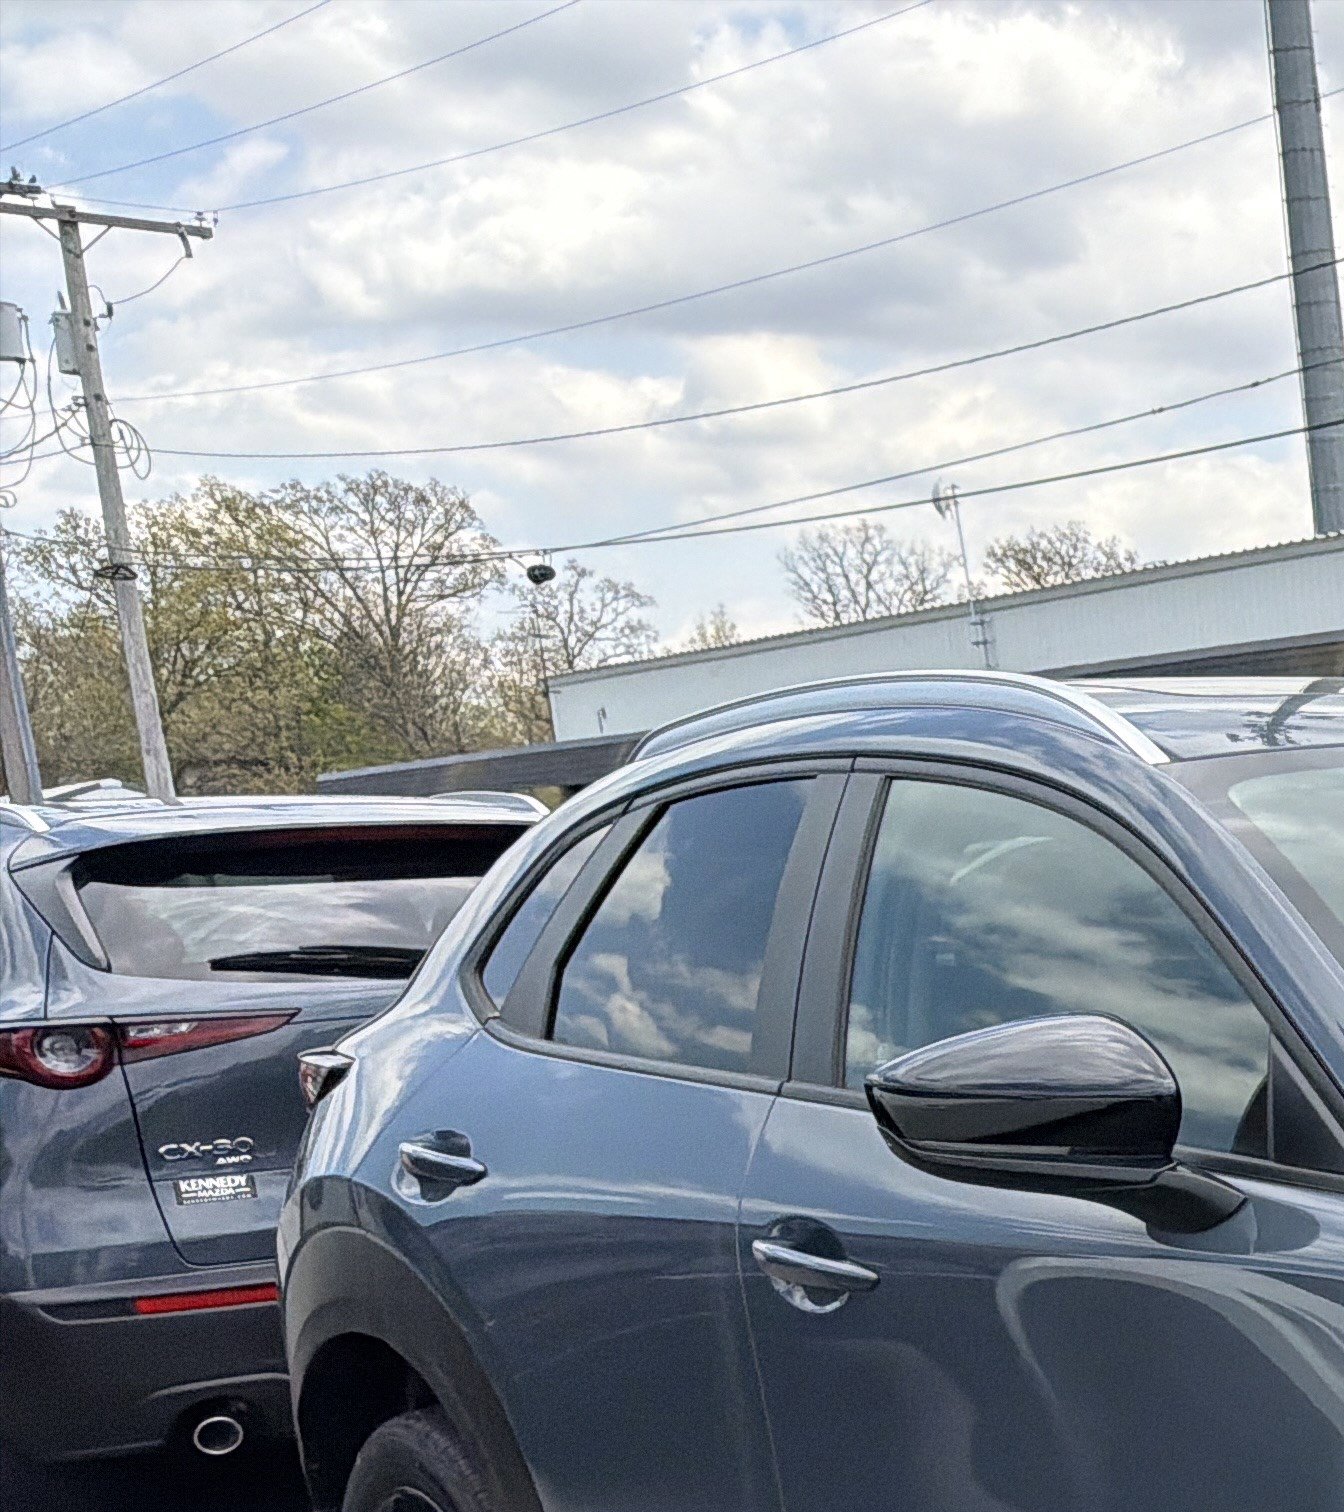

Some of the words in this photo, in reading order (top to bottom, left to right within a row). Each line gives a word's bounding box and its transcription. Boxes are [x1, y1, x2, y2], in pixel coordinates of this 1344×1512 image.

[158, 1136, 254, 1160] CX-30
[216, 1154, 253, 1165] AWD
[179, 1174, 247, 1192] KENNEDY
[197, 1187, 236, 1198] MAZDA
